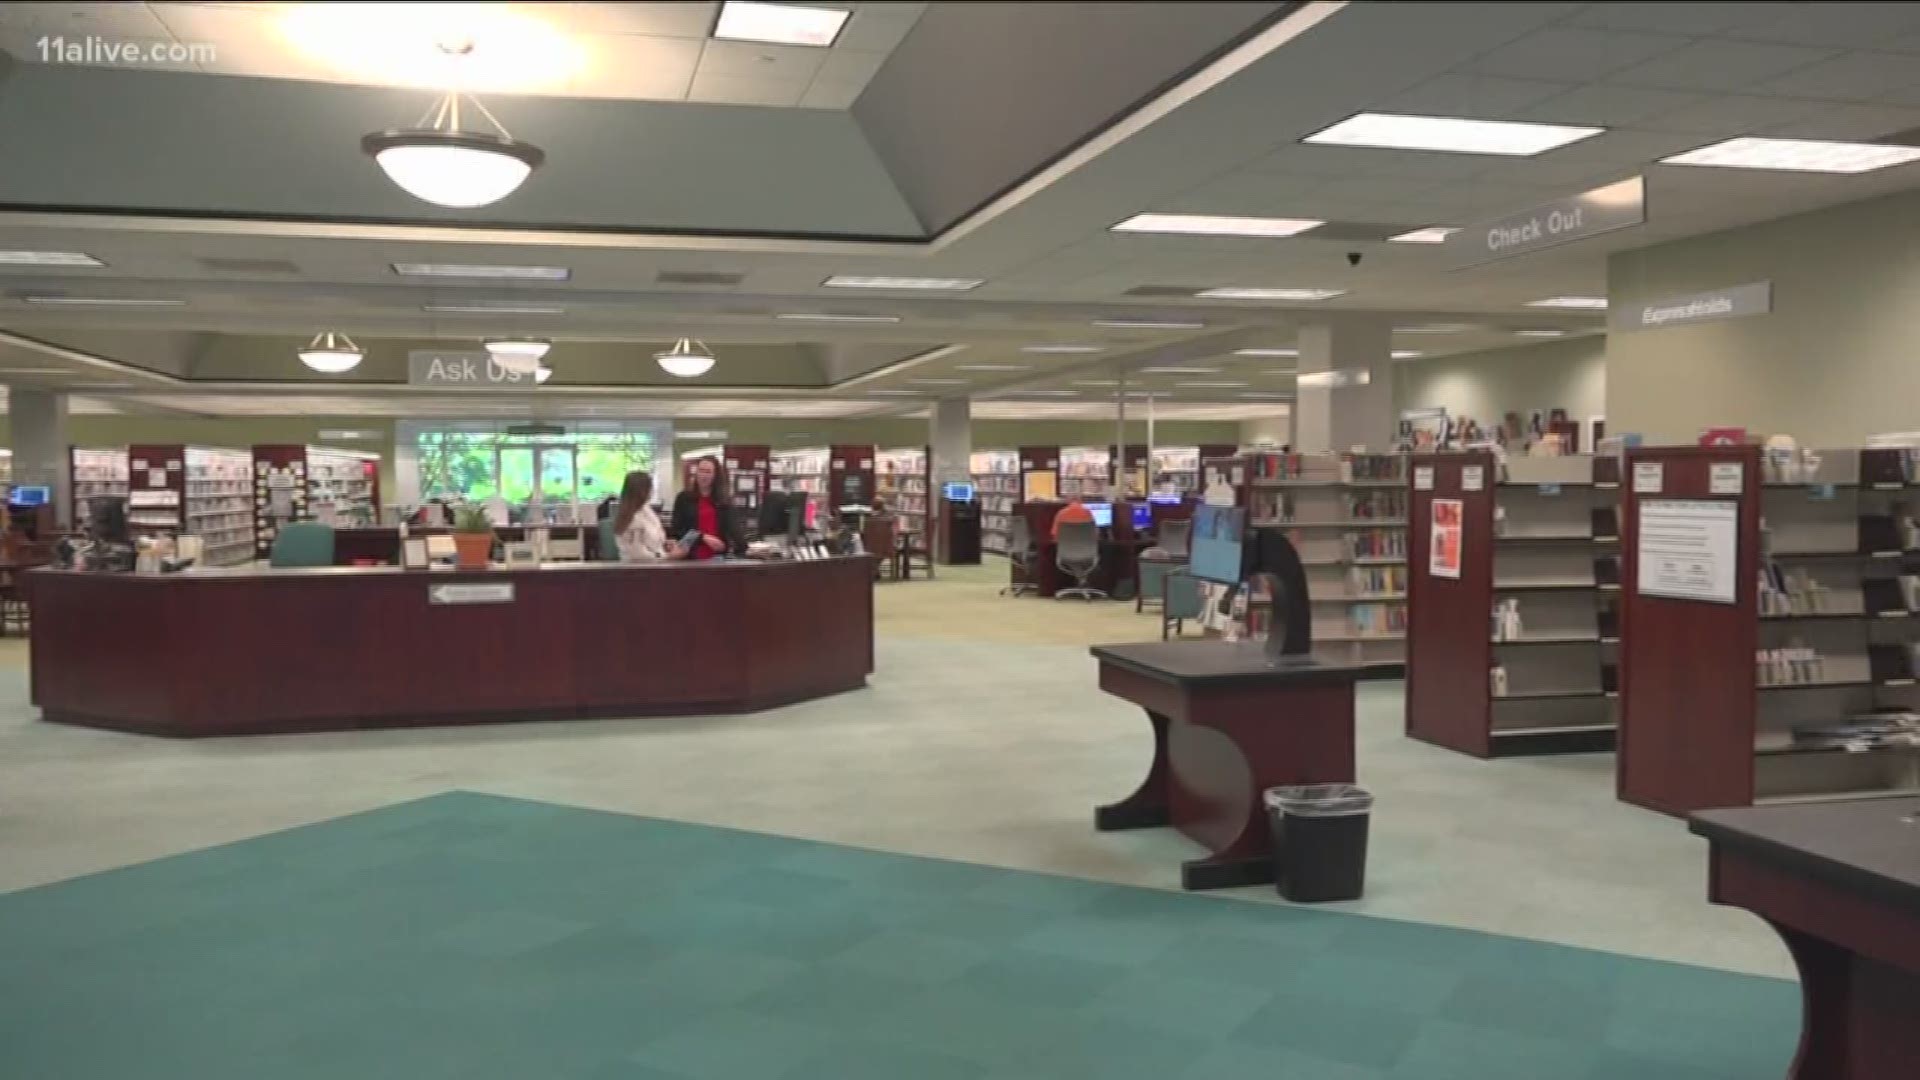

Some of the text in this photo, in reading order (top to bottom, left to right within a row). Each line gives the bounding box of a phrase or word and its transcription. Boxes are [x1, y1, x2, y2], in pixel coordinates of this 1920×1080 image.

[1488, 208, 1584, 252] Check Out
[426, 356, 522, 382] Ask Us
